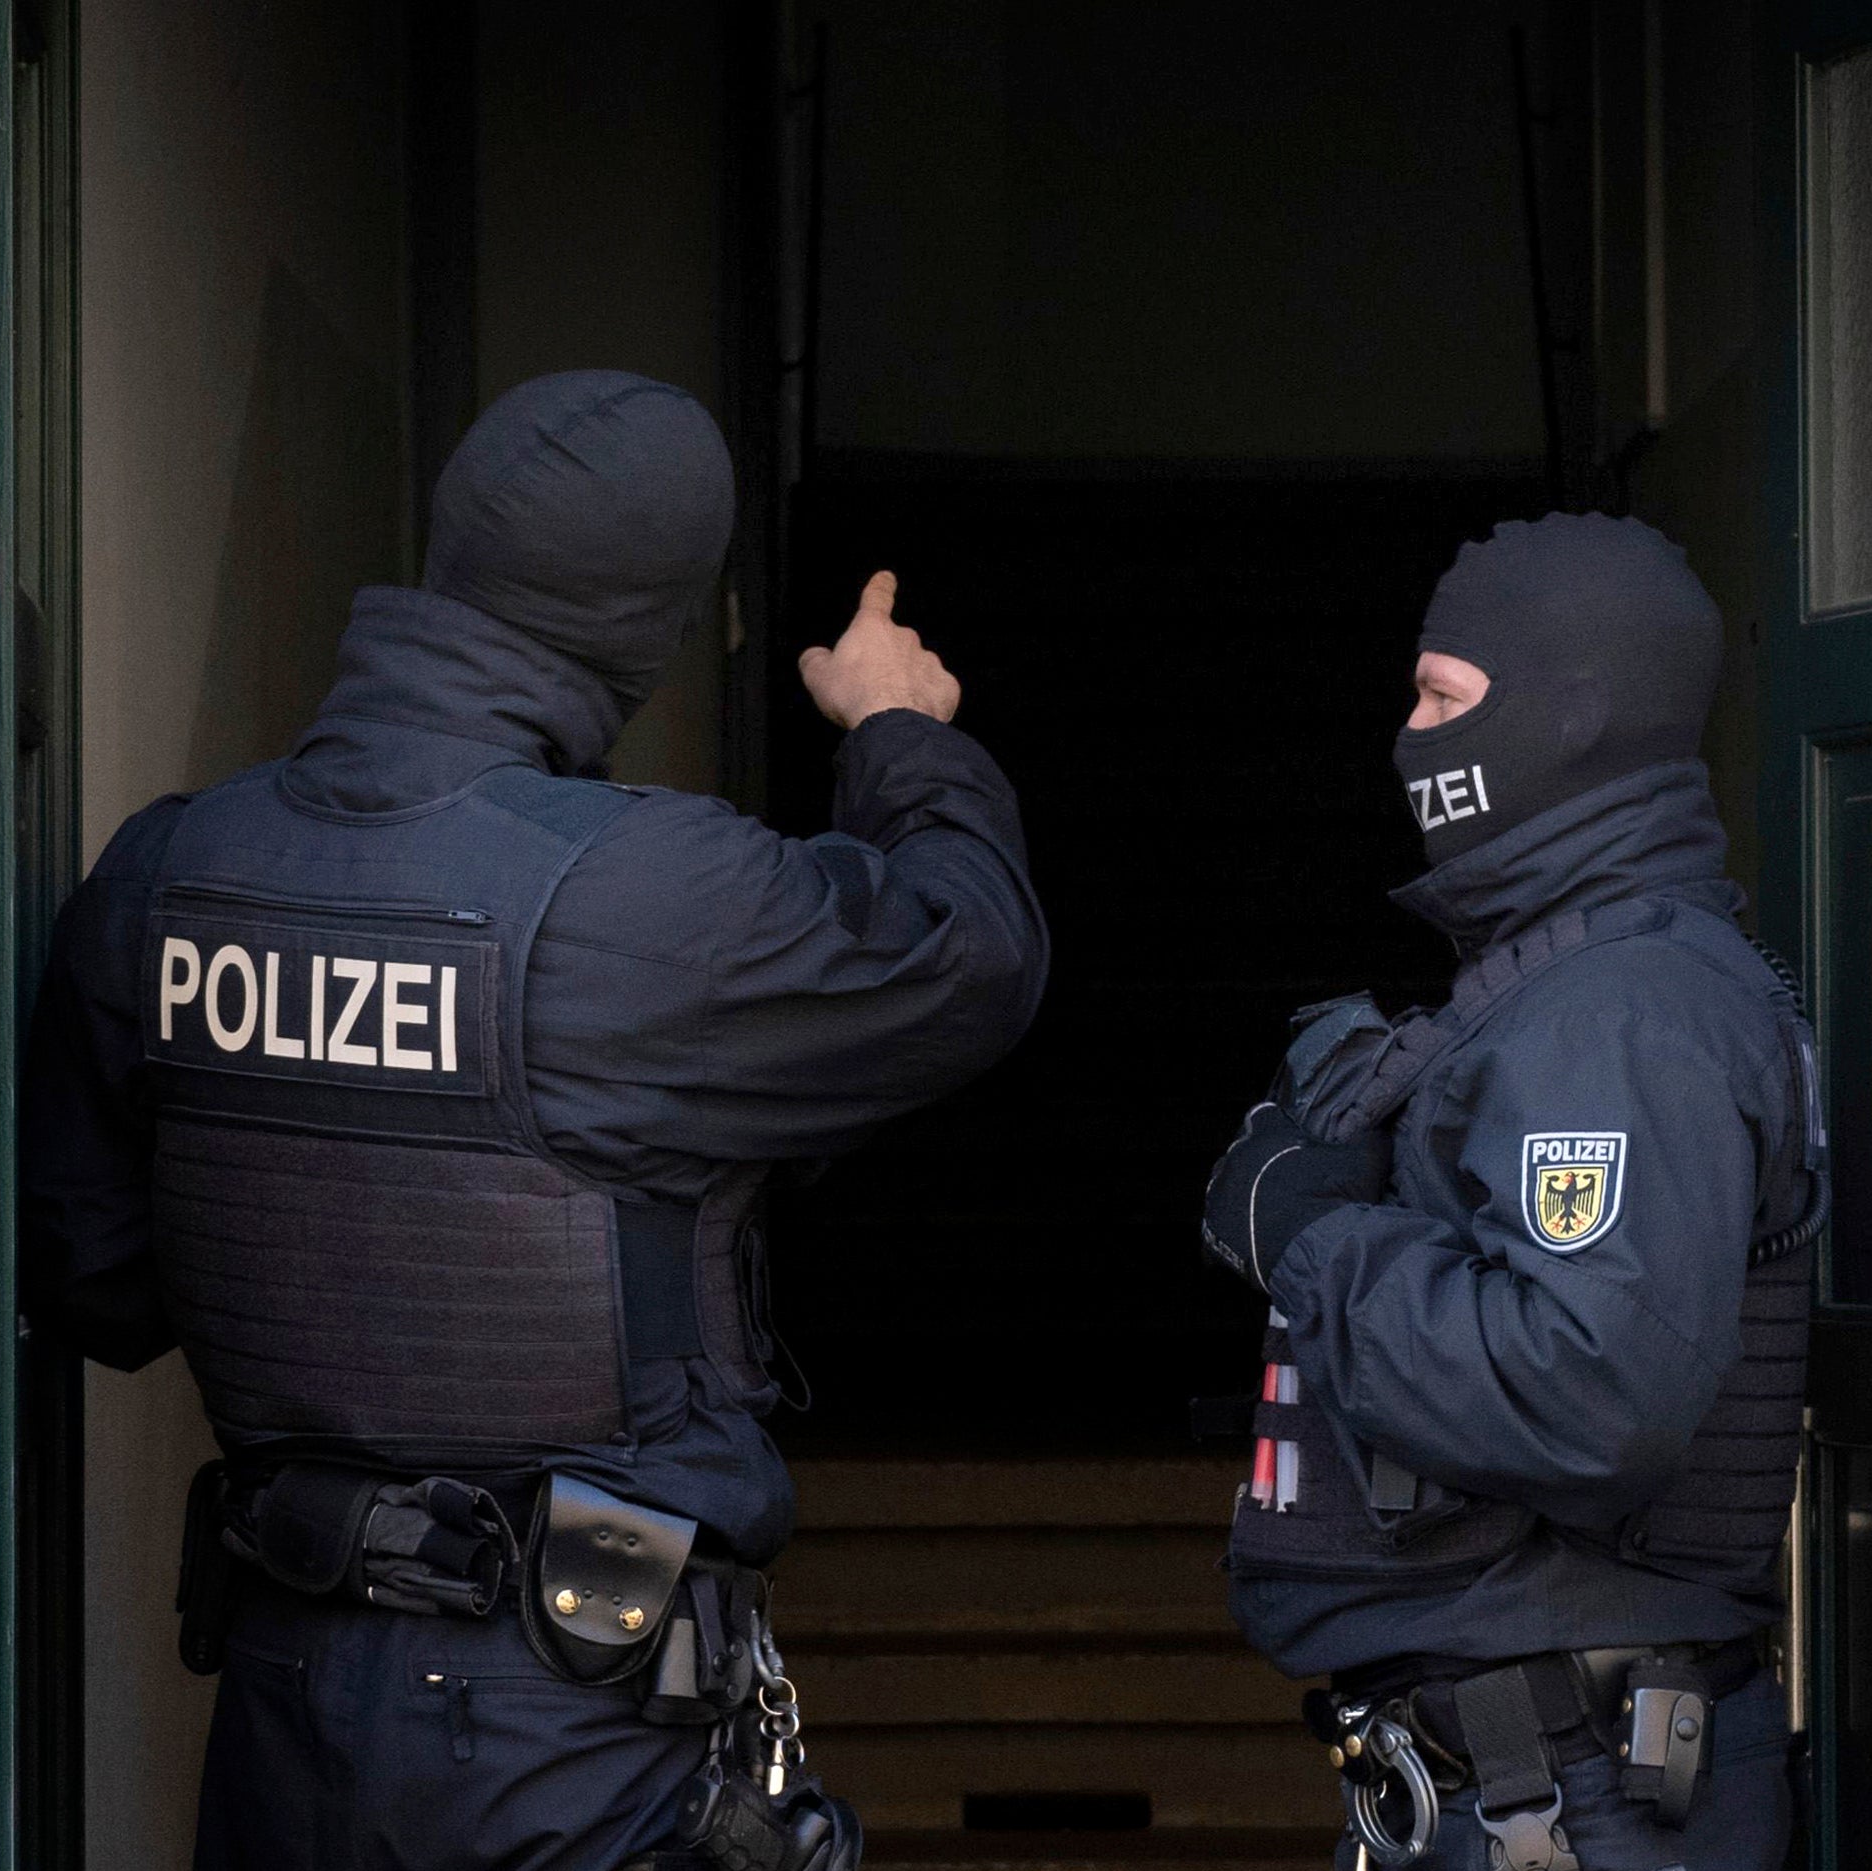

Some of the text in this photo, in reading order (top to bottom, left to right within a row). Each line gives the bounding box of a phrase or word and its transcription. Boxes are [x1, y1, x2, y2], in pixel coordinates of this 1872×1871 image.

[1405, 765, 1490, 833] ZEI
[160, 936, 458, 1072] POLIZEI
[1532, 1140, 1616, 1164] POLIZEI
